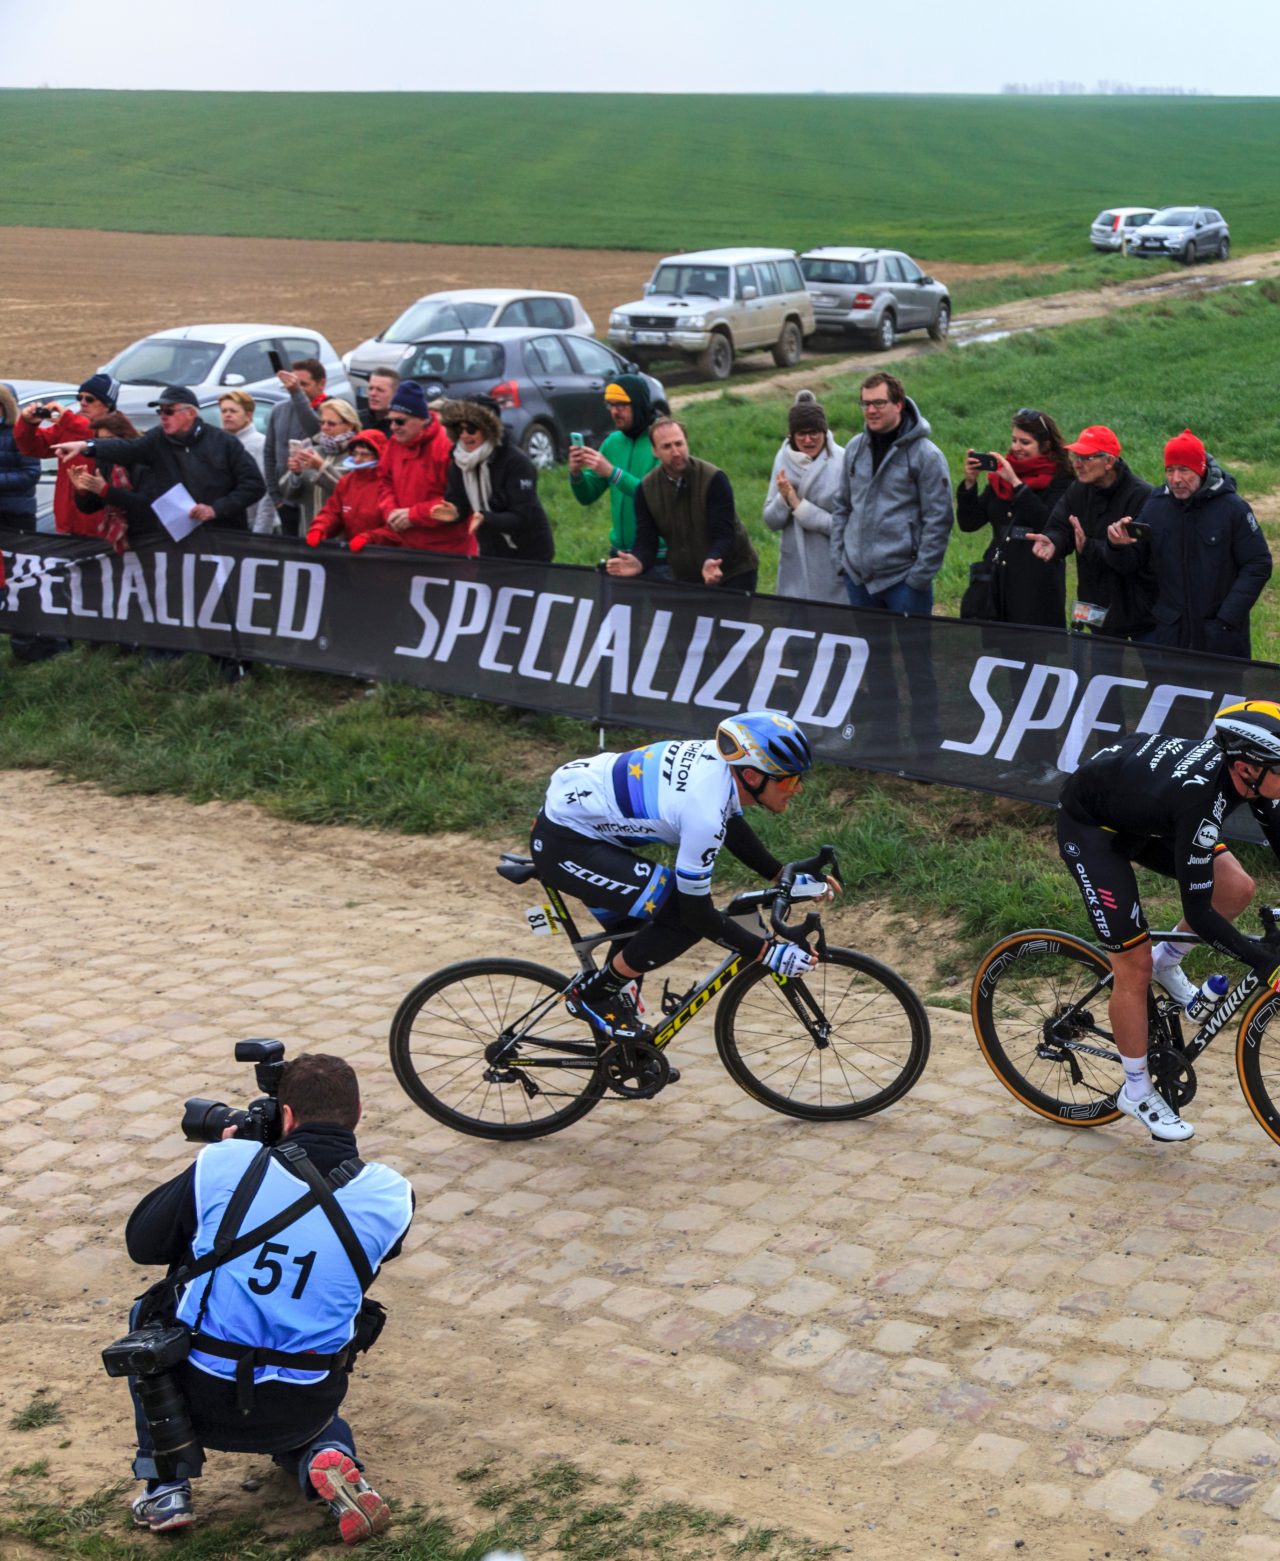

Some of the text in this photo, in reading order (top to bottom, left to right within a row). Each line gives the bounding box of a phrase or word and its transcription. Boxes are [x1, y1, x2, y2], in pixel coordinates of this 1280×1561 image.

[0, 551, 326, 641] PECIALIZED
[394, 577, 869, 729] SPECIALIZED
[558, 860, 641, 895] SCOTT
[528, 913, 548, 930] 81
[654, 956, 742, 1048] SCOTT
[1193, 968, 1259, 1051] S-WORKS
[247, 1242, 318, 1301] 51
